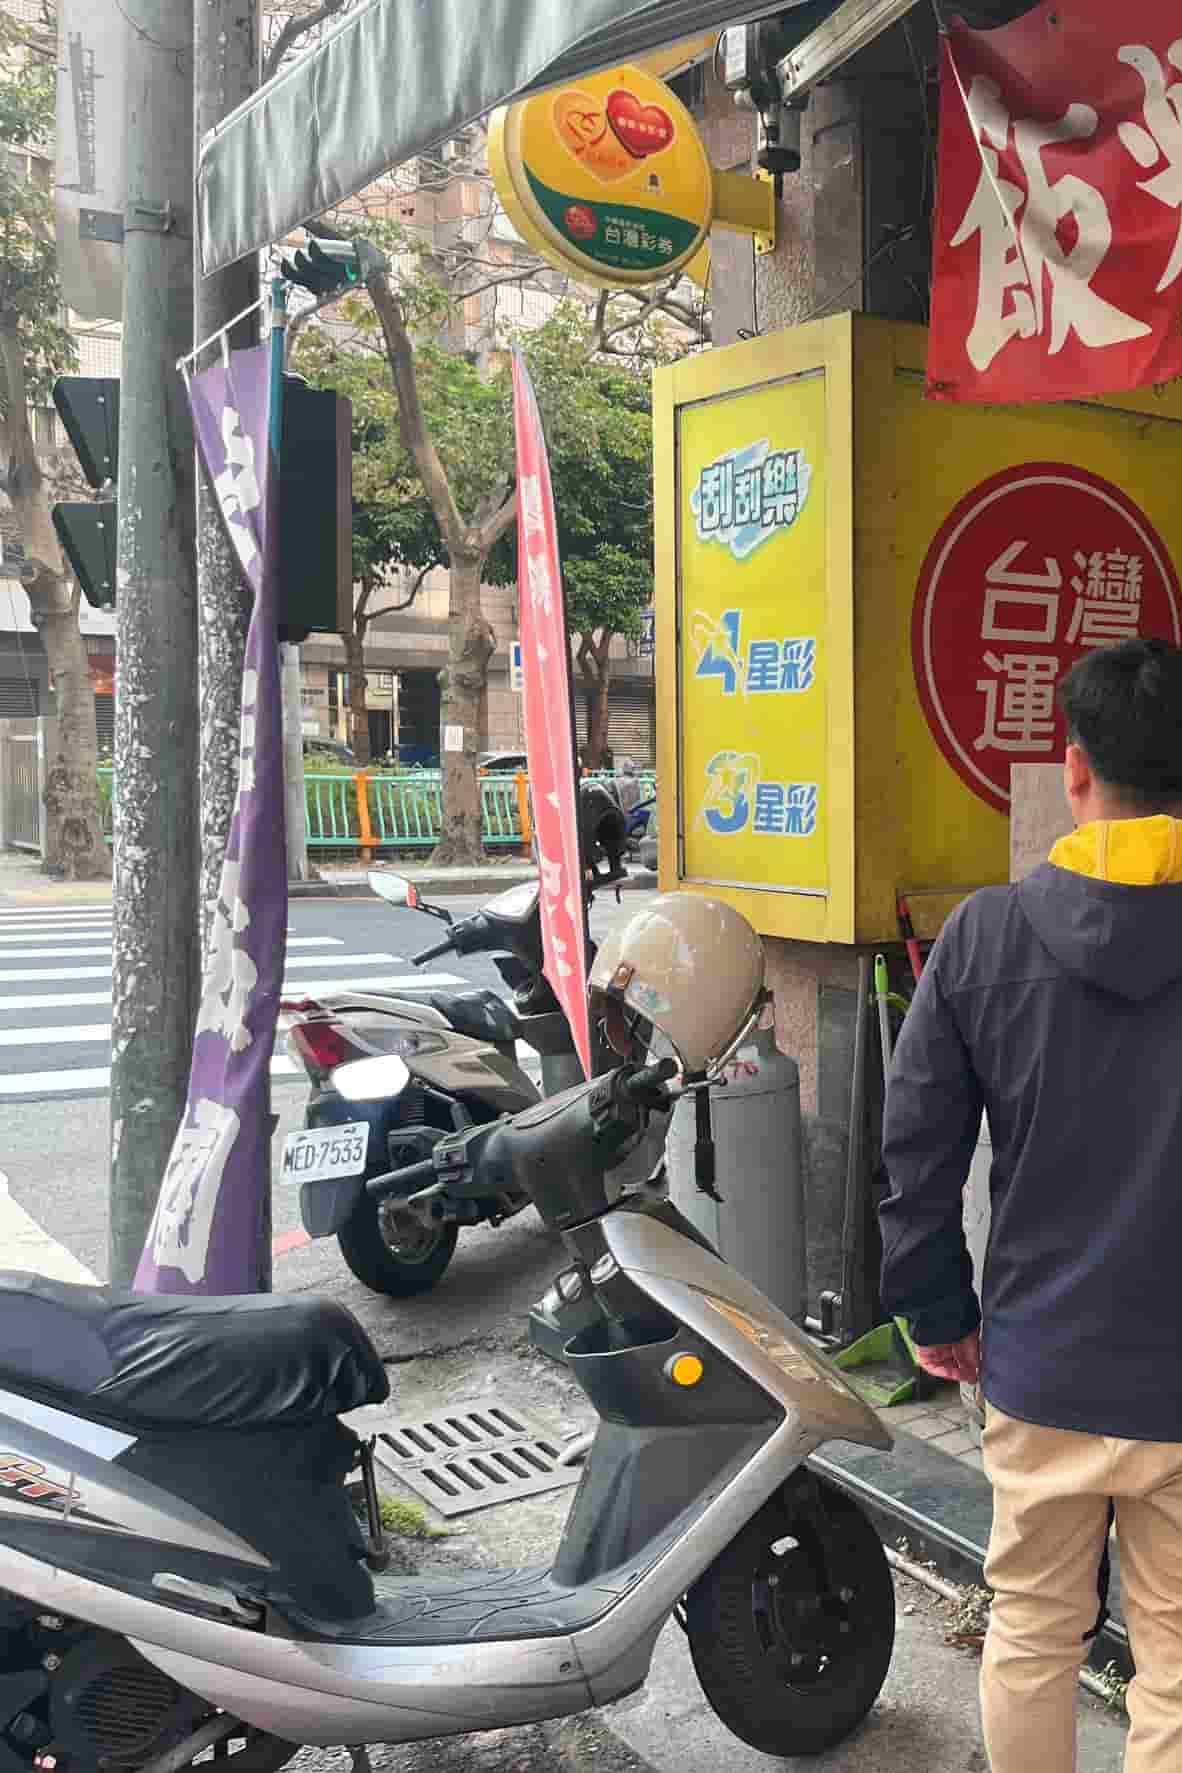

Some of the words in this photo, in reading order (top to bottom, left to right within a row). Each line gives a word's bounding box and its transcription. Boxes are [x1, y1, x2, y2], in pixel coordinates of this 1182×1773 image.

[700, 452, 800, 532] 刮刮樂
[981, 541, 1145, 646] 台灣
[692, 609, 816, 694] 4星彩
[973, 650, 1060, 751] 運
[704, 752, 817, 834] 3星彩
[283, 1136, 364, 1172] MED-7533
